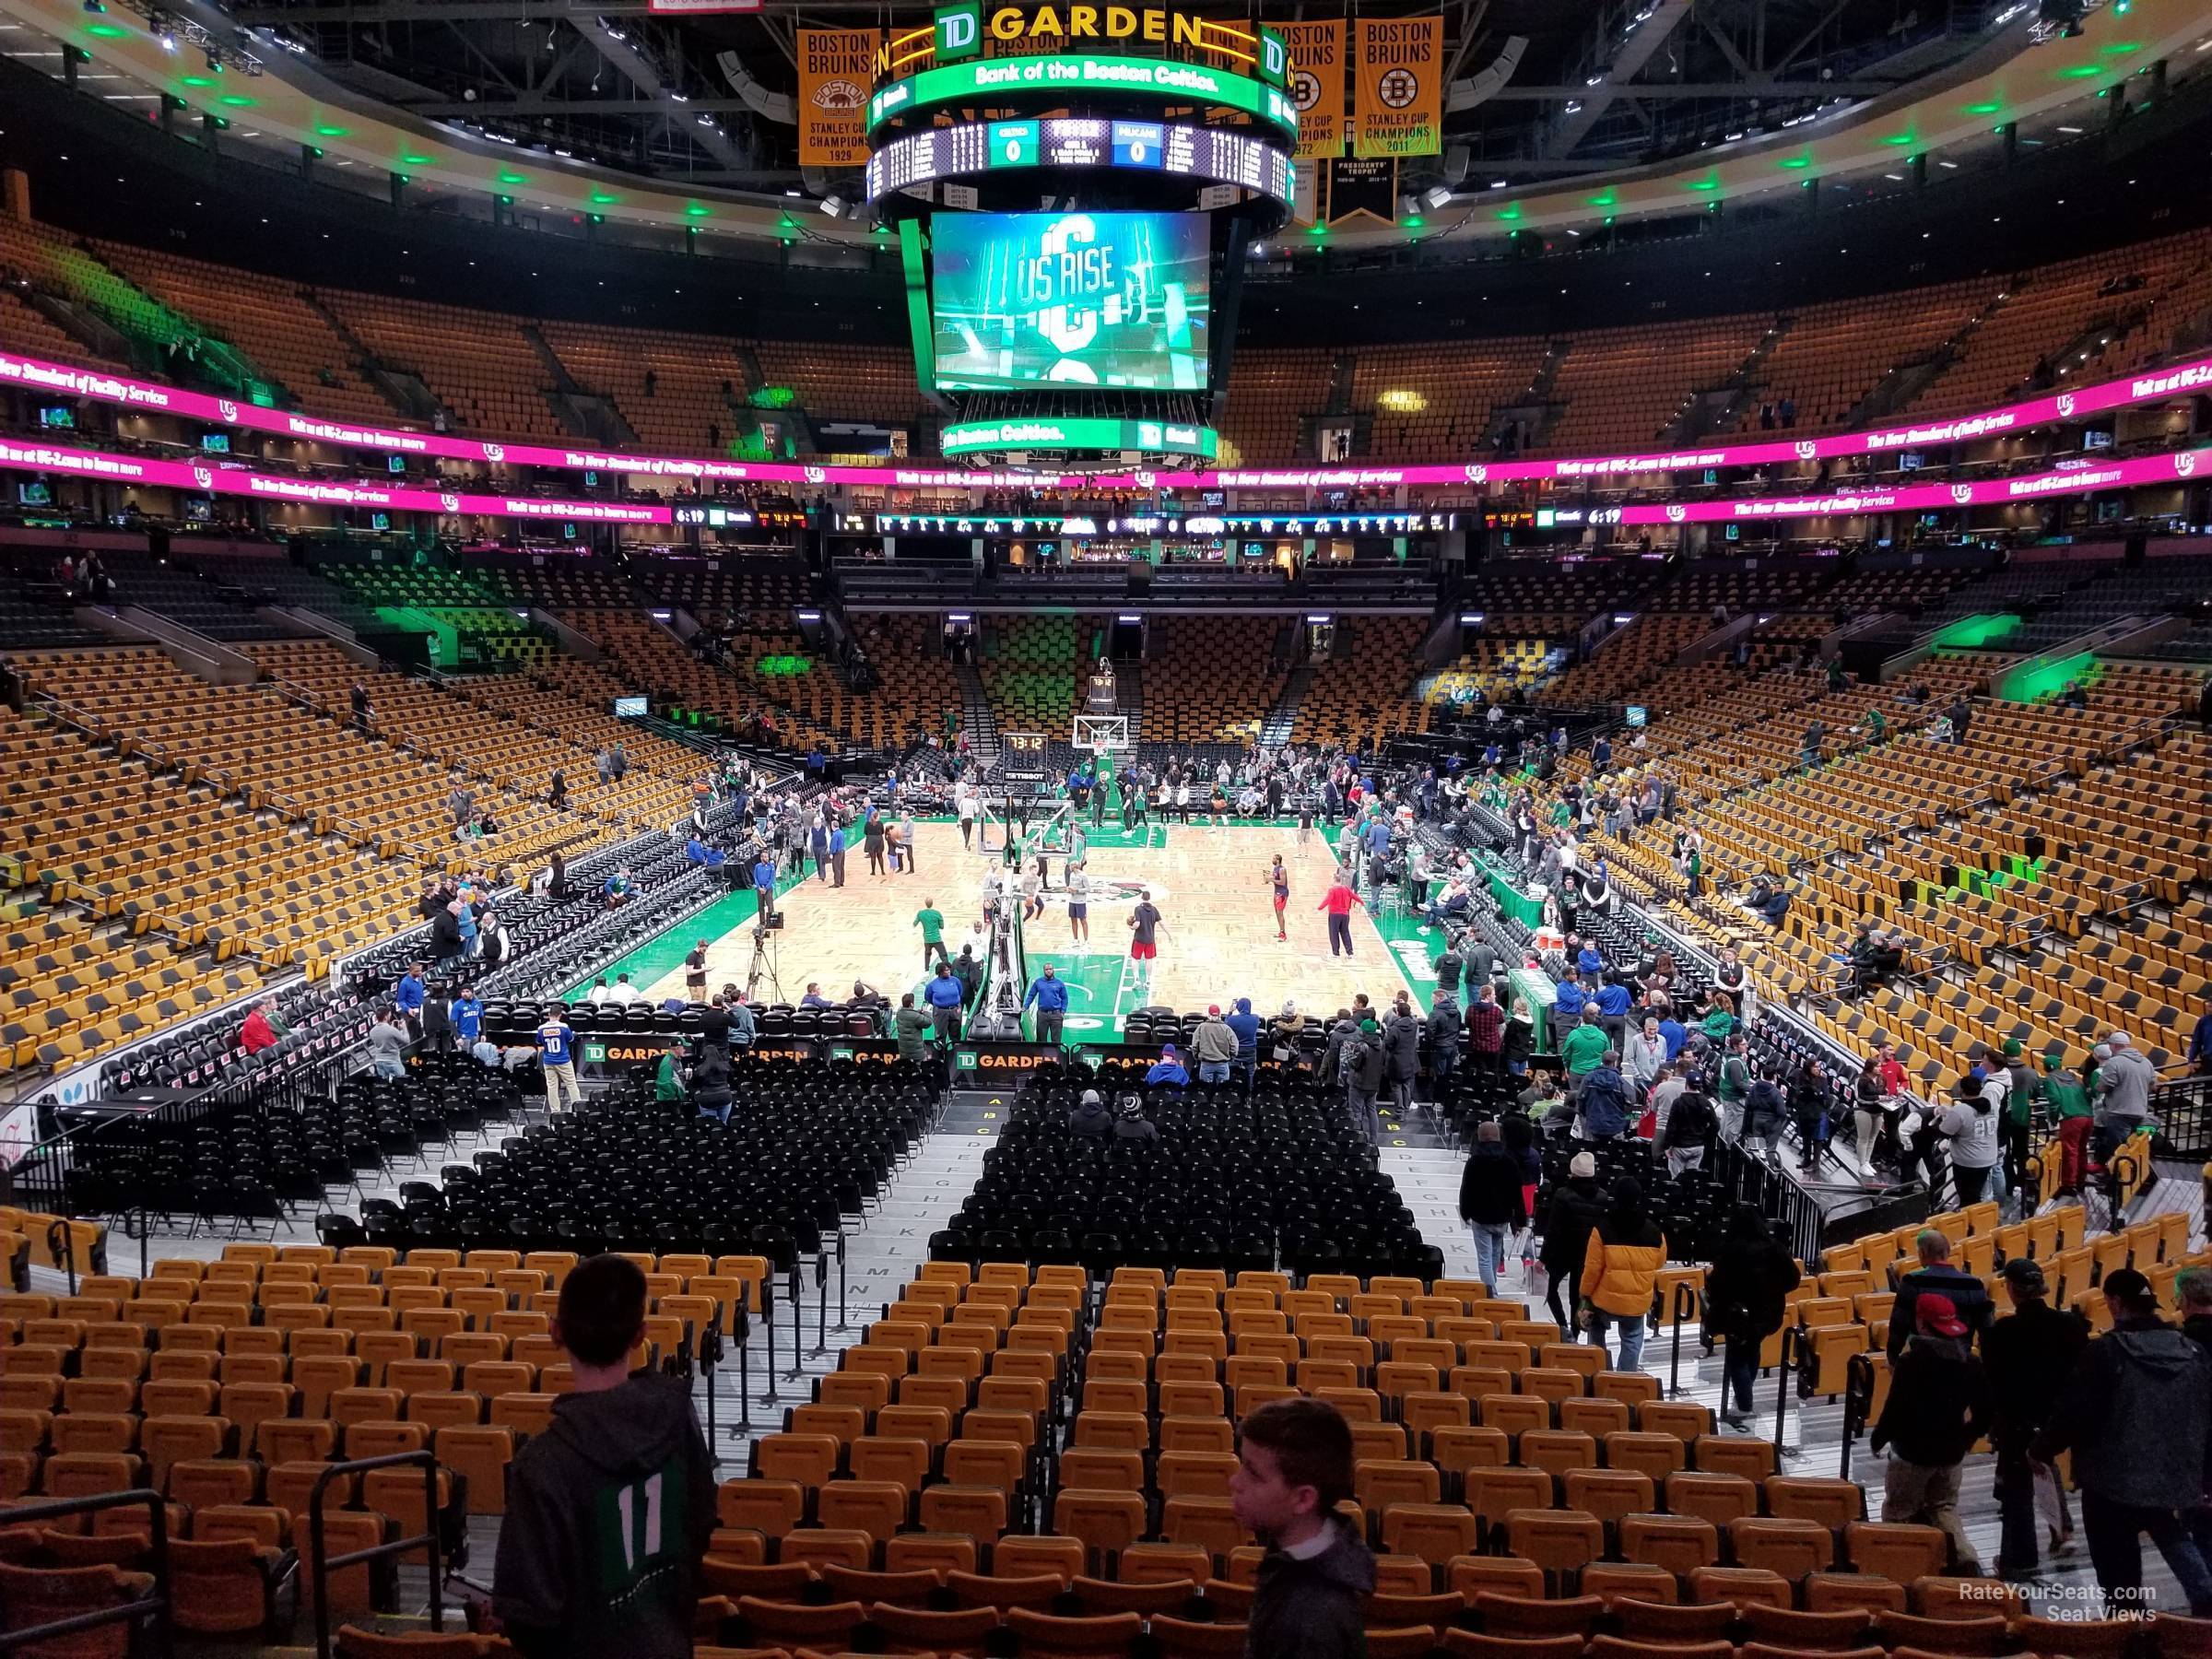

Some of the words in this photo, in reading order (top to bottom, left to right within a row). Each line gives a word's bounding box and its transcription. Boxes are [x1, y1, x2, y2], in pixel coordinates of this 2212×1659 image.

[939, 13, 974, 48] TD
[991, 6, 1201, 46] GARDEN
[1367, 22, 1431, 42] BOSTON
[808, 34, 870, 53] BOSTON
[1264, 36, 1283, 74] TD
[1367, 43, 1430, 64] BRUINS
[808, 54, 869, 74] BRUINS
[975, 62, 1020, 85] Bank
[1024, 61, 1044, 80] of
[1047, 61, 1079, 79] the
[1083, 61, 1151, 82] Boston
[1154, 65, 1218, 92] Celtics.
[814, 80, 866, 106] BOSTON
[1315, 115, 1332, 126] CUP
[1367, 112, 1408, 125] STANLEY
[1411, 112, 1430, 124] CUP
[810, 123, 851, 134] STANLEY
[1366, 126, 1430, 139] CHAMPIONS
[1006, 139, 1021, 162] 0
[1130, 140, 1145, 162] 0
[1386, 141, 1408, 152] 2011
[830, 151, 852, 161] 1929
[1018, 253, 1053, 303] US
[1059, 245, 1114, 296] RISE
[76, 375, 88, 394] of
[128, 385, 168, 406] Services
[1953, 424, 1961, 440] of
[566, 453, 584, 465] The
[652, 461, 665, 475] of
[704, 464, 747, 477] Services
[1698, 453, 1724, 464] more
[1218, 473, 1237, 485] The
[1309, 472, 1321, 486] of
[1359, 471, 1403, 482] Services
[1735, 503, 1752, 514] The
[1820, 500, 1831, 512] of
[1862, 495, 1895, 507] Services
[676, 510, 705, 523] 6:19
[1588, 509, 1622, 524] 6:19
[1010, 737, 1042, 749] 73:12
[545, 1038, 560, 1053] 10
[586, 1048, 604, 1059] TD
[959, 1054, 975, 1066] TD
[1974, 1117, 1997, 1137] 20
[899, 1228, 916, 1236] K
[888, 1247, 902, 1255] L
[1450, 1244, 1467, 1253] K
[1464, 1265, 1479, 1274] L
[848, 1285, 869, 1293] N
[618, 1473, 662, 1571] 11
